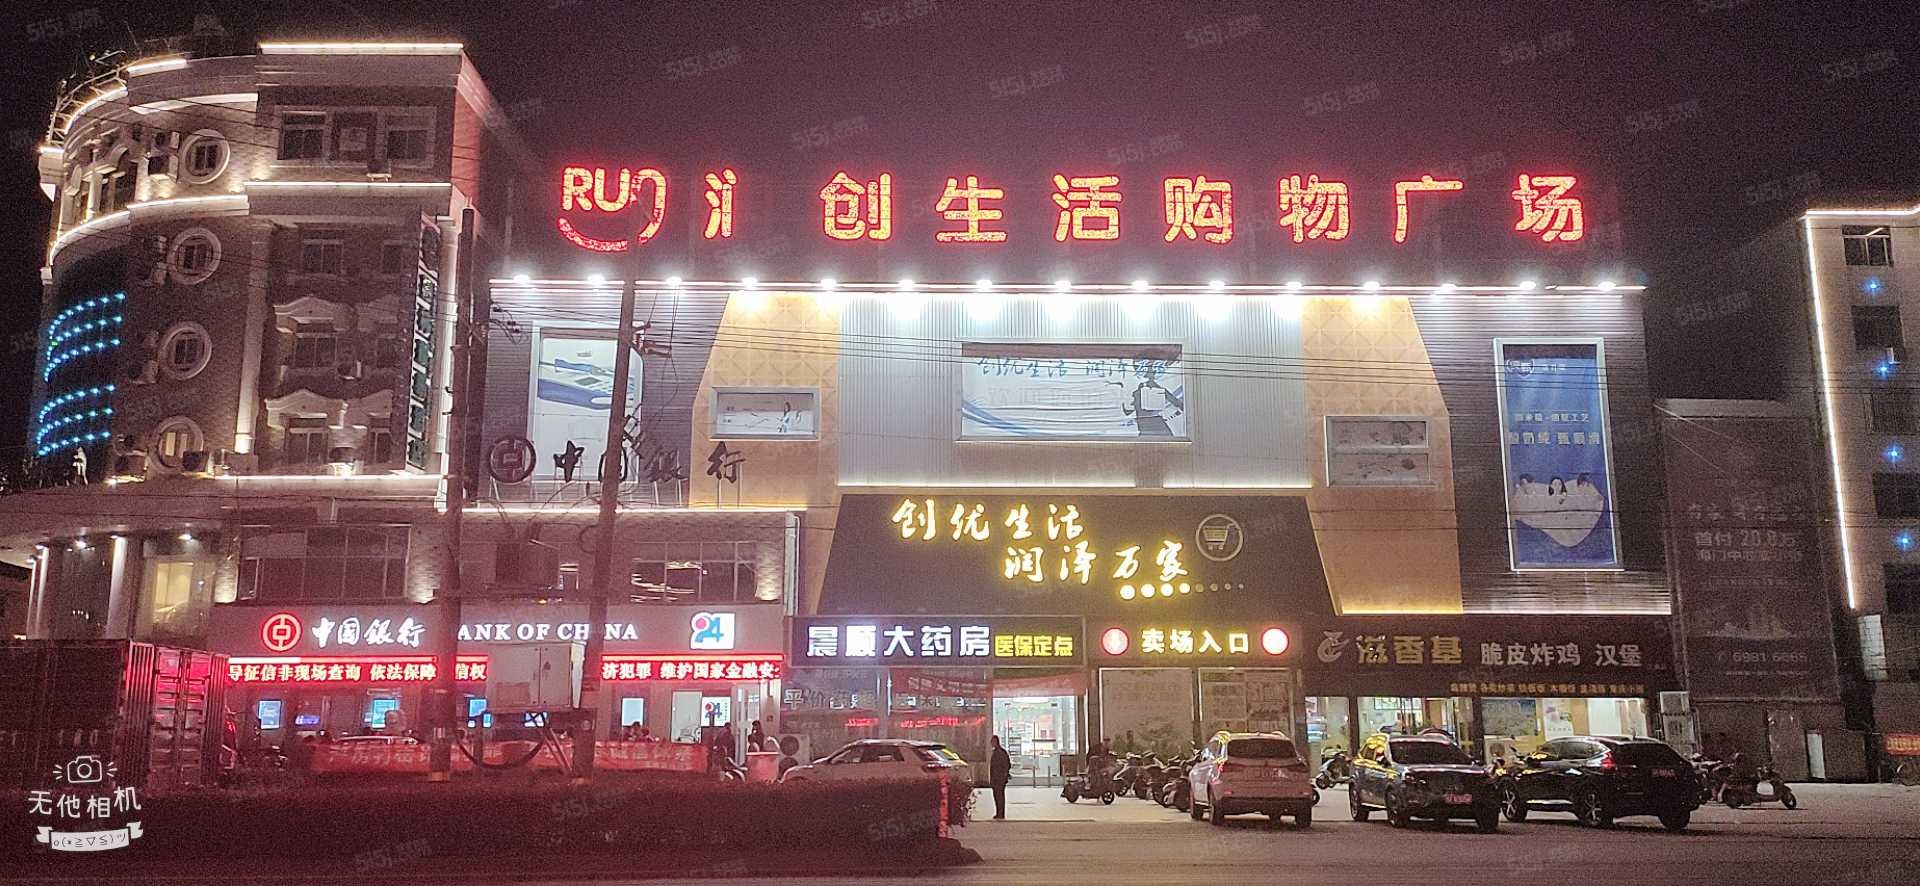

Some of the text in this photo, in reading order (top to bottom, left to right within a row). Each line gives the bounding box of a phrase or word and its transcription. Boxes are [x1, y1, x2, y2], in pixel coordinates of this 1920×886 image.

[703, 168, 1586, 243] 创生活购物广场
[553, 441, 746, 483] 中银行
[892, 499, 1083, 541] 创优生活
[1004, 540, 1188, 584] 润泽万家
[312, 617, 425, 648] 中国银行
[457, 624, 511, 641] ANK
[517, 624, 549, 641] OF
[557, 624, 639, 641] CHNA
[994, 634, 1074, 657] 医保定点
[1141, 628, 1249, 654] 卖场入口
[1481, 642, 1581, 667] 脆皮炸鸡
[1595, 642, 1642, 668] 汉堡
